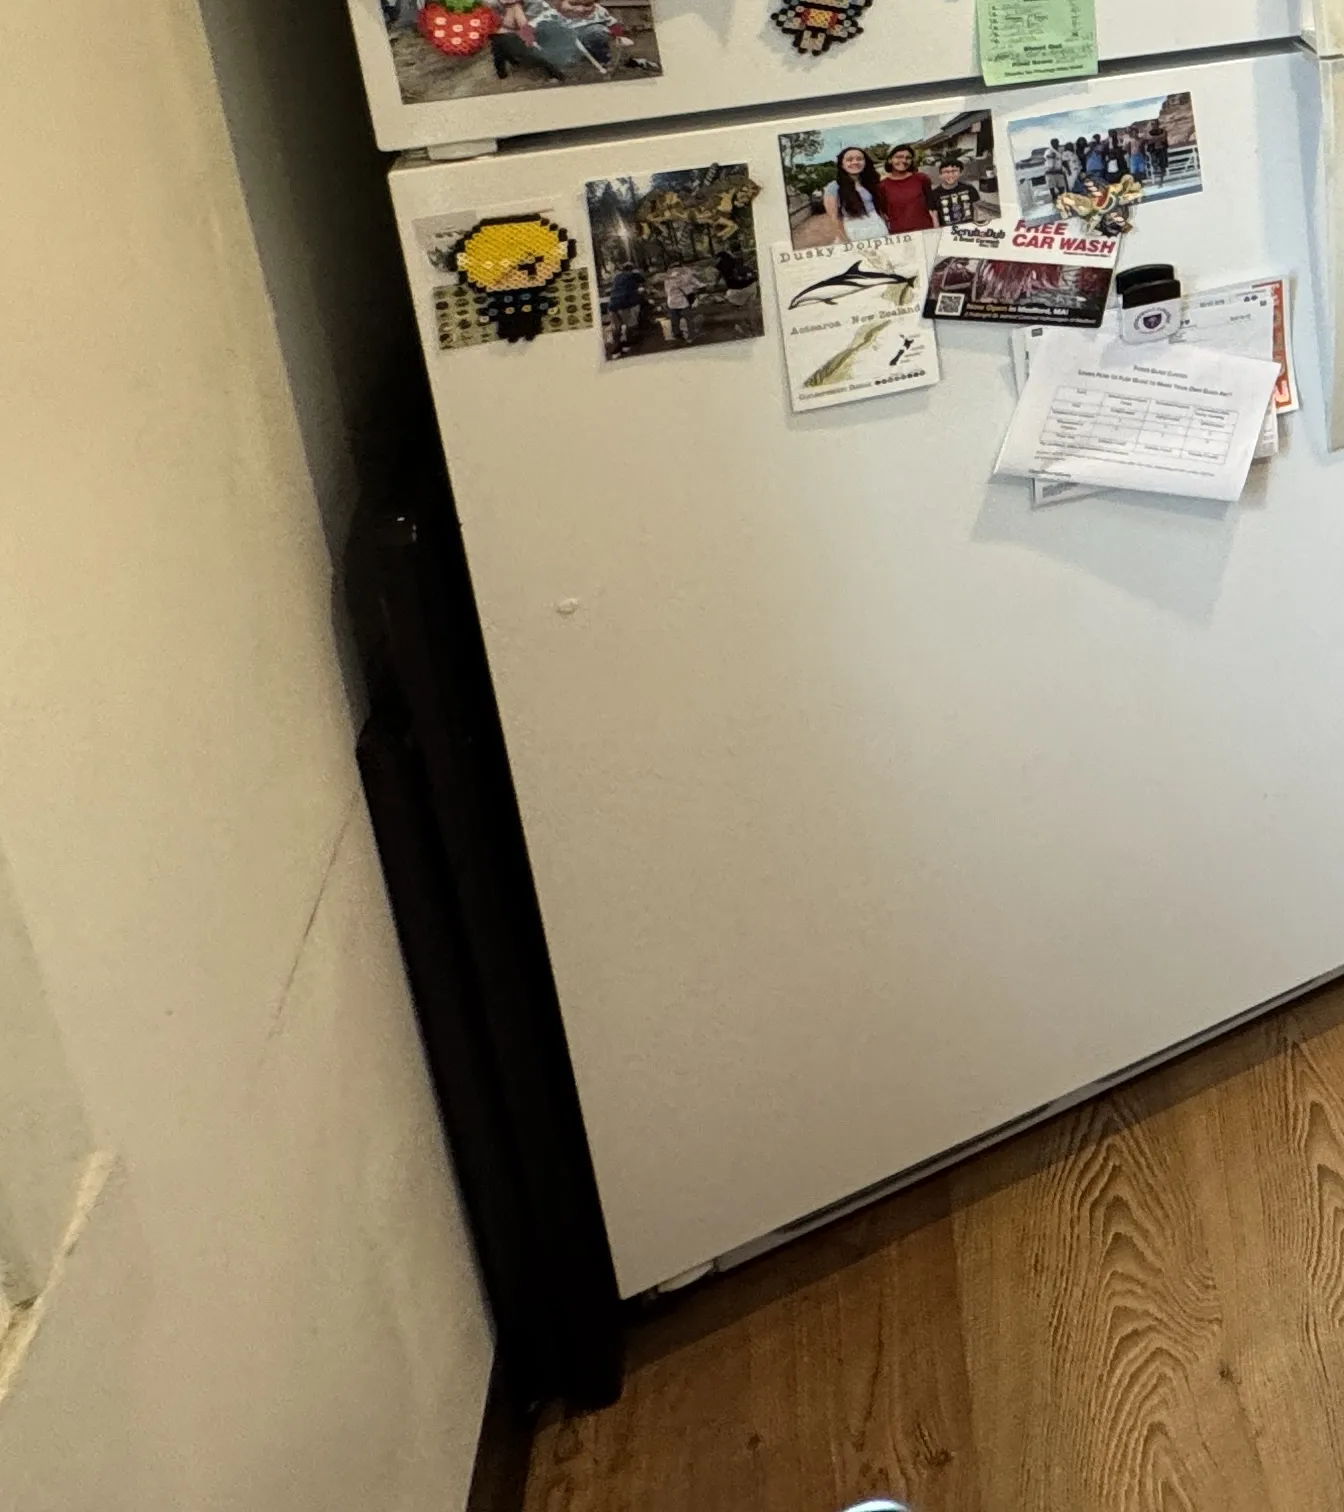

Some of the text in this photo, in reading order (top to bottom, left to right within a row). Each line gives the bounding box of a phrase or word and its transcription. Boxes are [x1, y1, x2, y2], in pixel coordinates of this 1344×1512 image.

[1015, 220, 1068, 235] FREE
[779, 234, 913, 264] Dusky Dolphin
[1012, 234, 1117, 255] CAR WASH
[852, 314, 875, 325] New
[879, 304, 921, 319] Zealand
